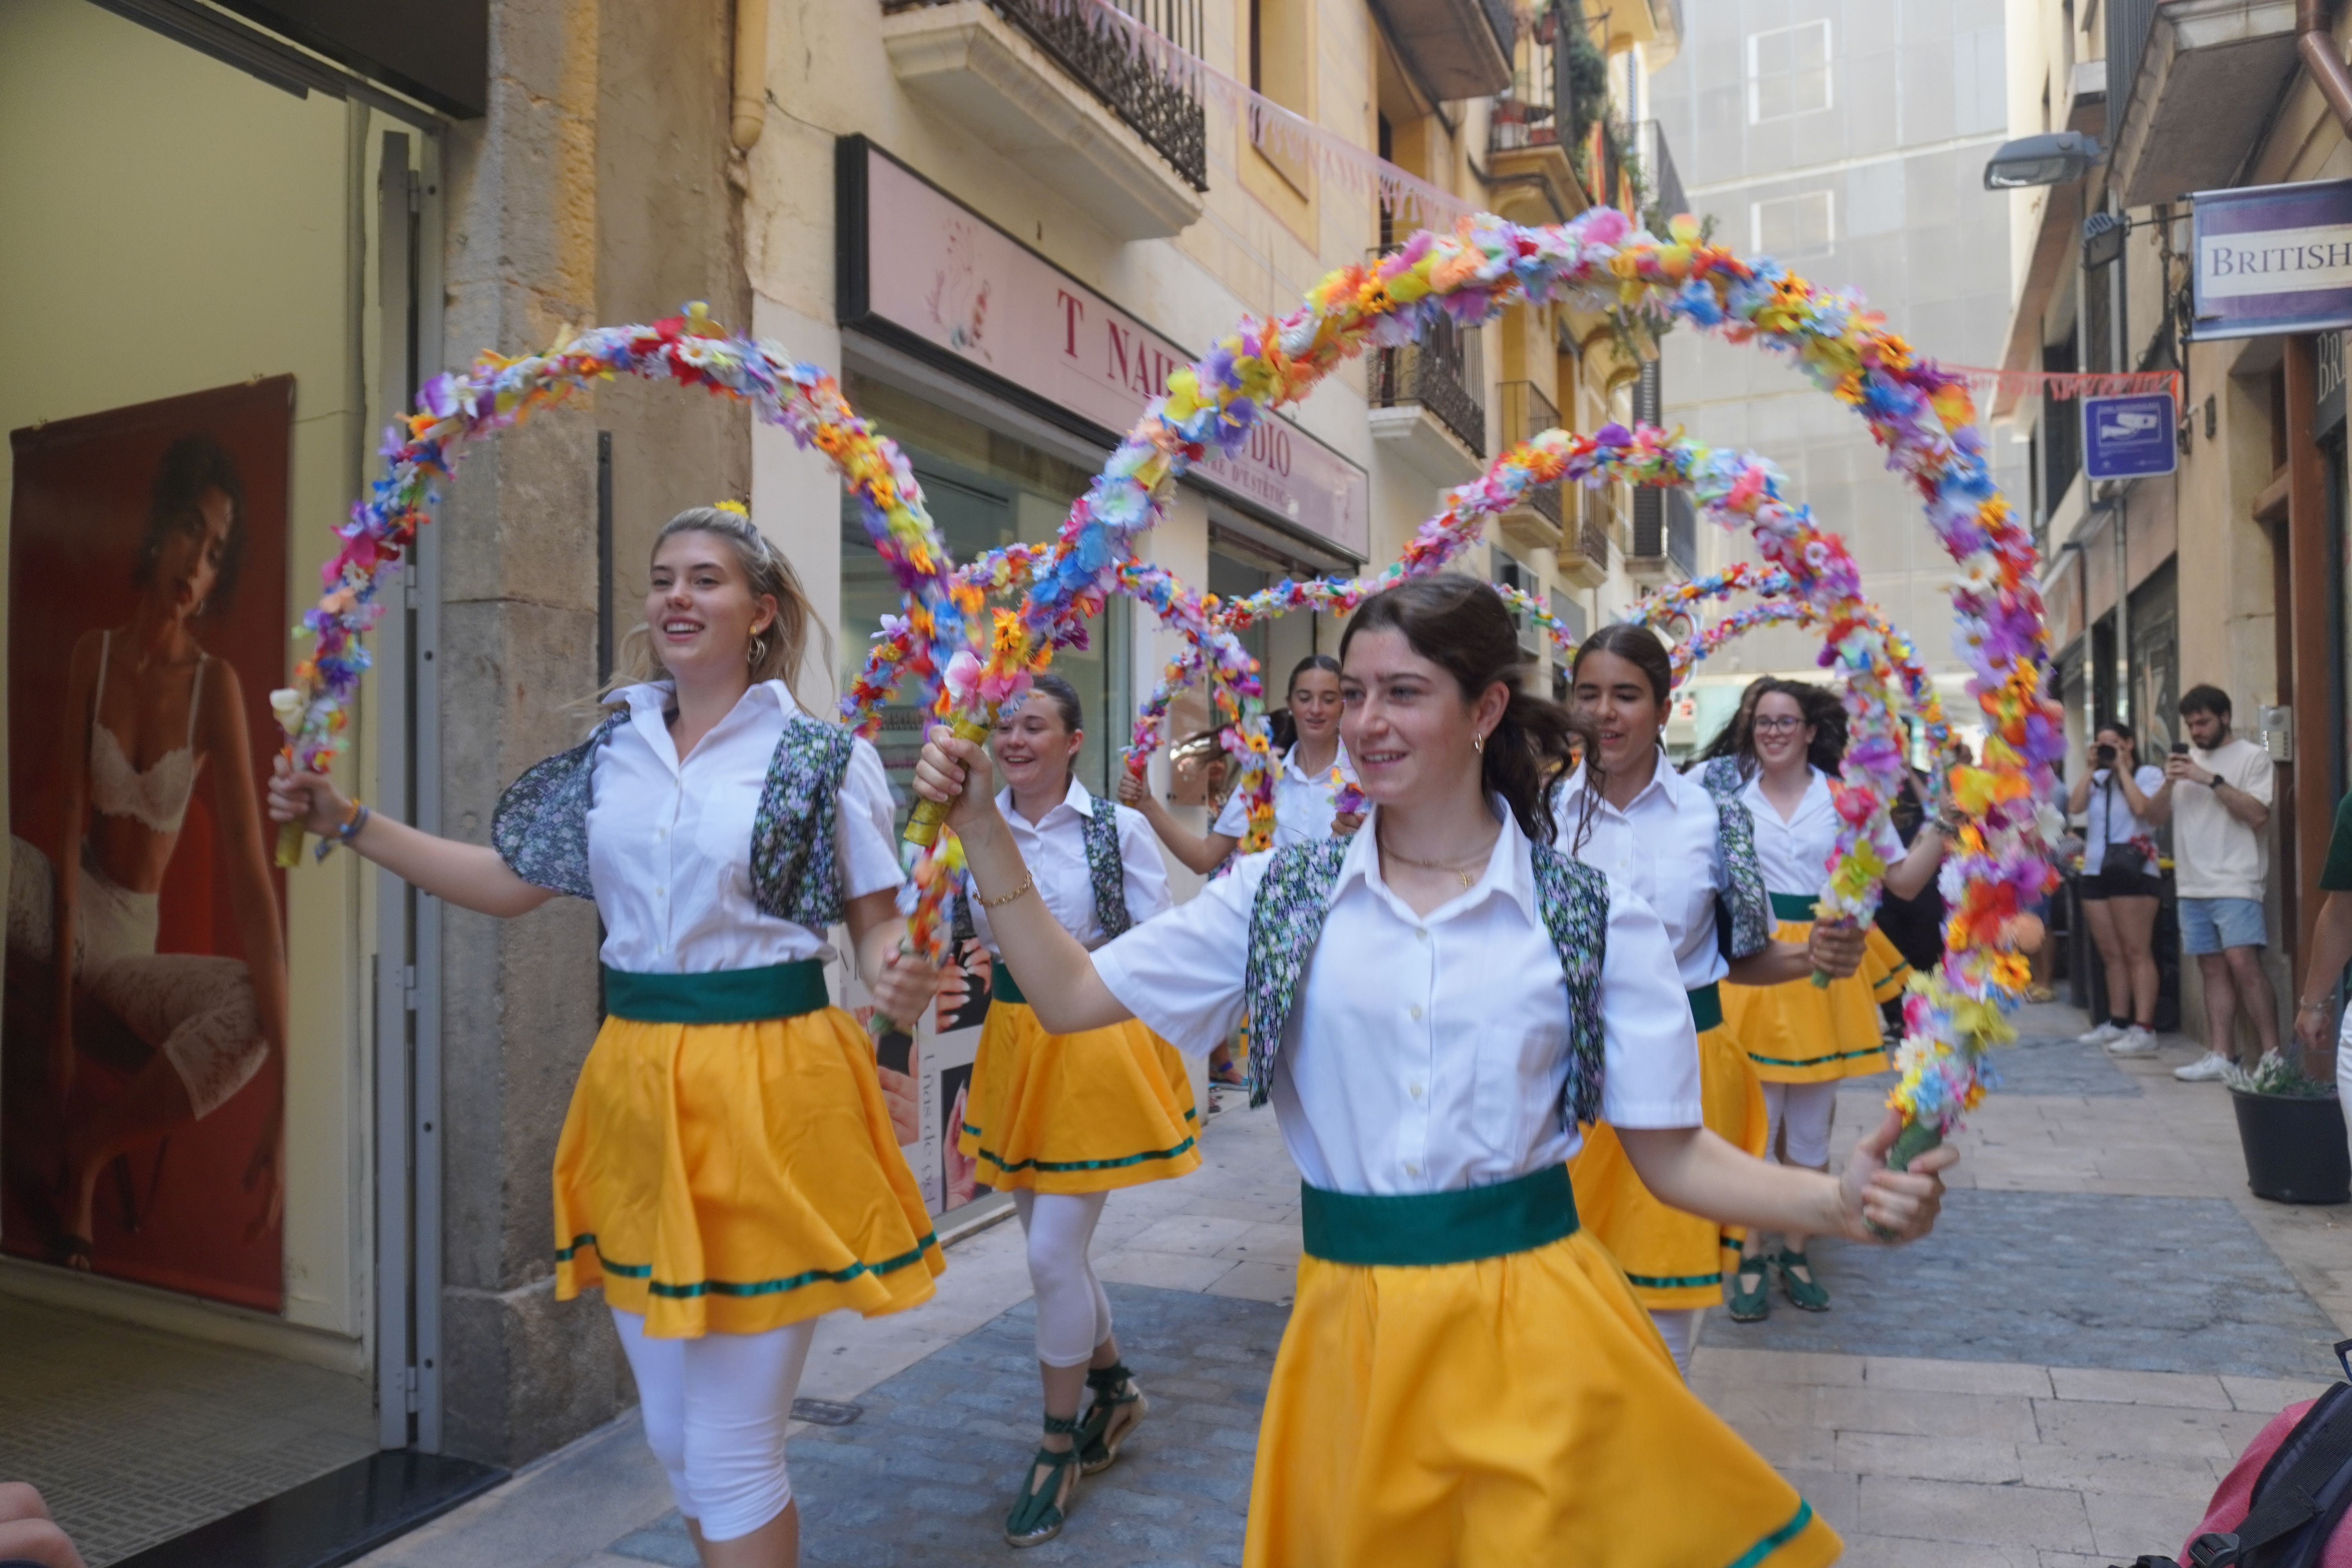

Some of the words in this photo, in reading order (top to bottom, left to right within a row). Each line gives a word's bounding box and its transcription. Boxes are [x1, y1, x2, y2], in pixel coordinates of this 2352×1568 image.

[2211, 242, 2352, 276] BRITISH
[1057, 288, 1083, 359] T
[1250, 416, 1291, 477] DIO
